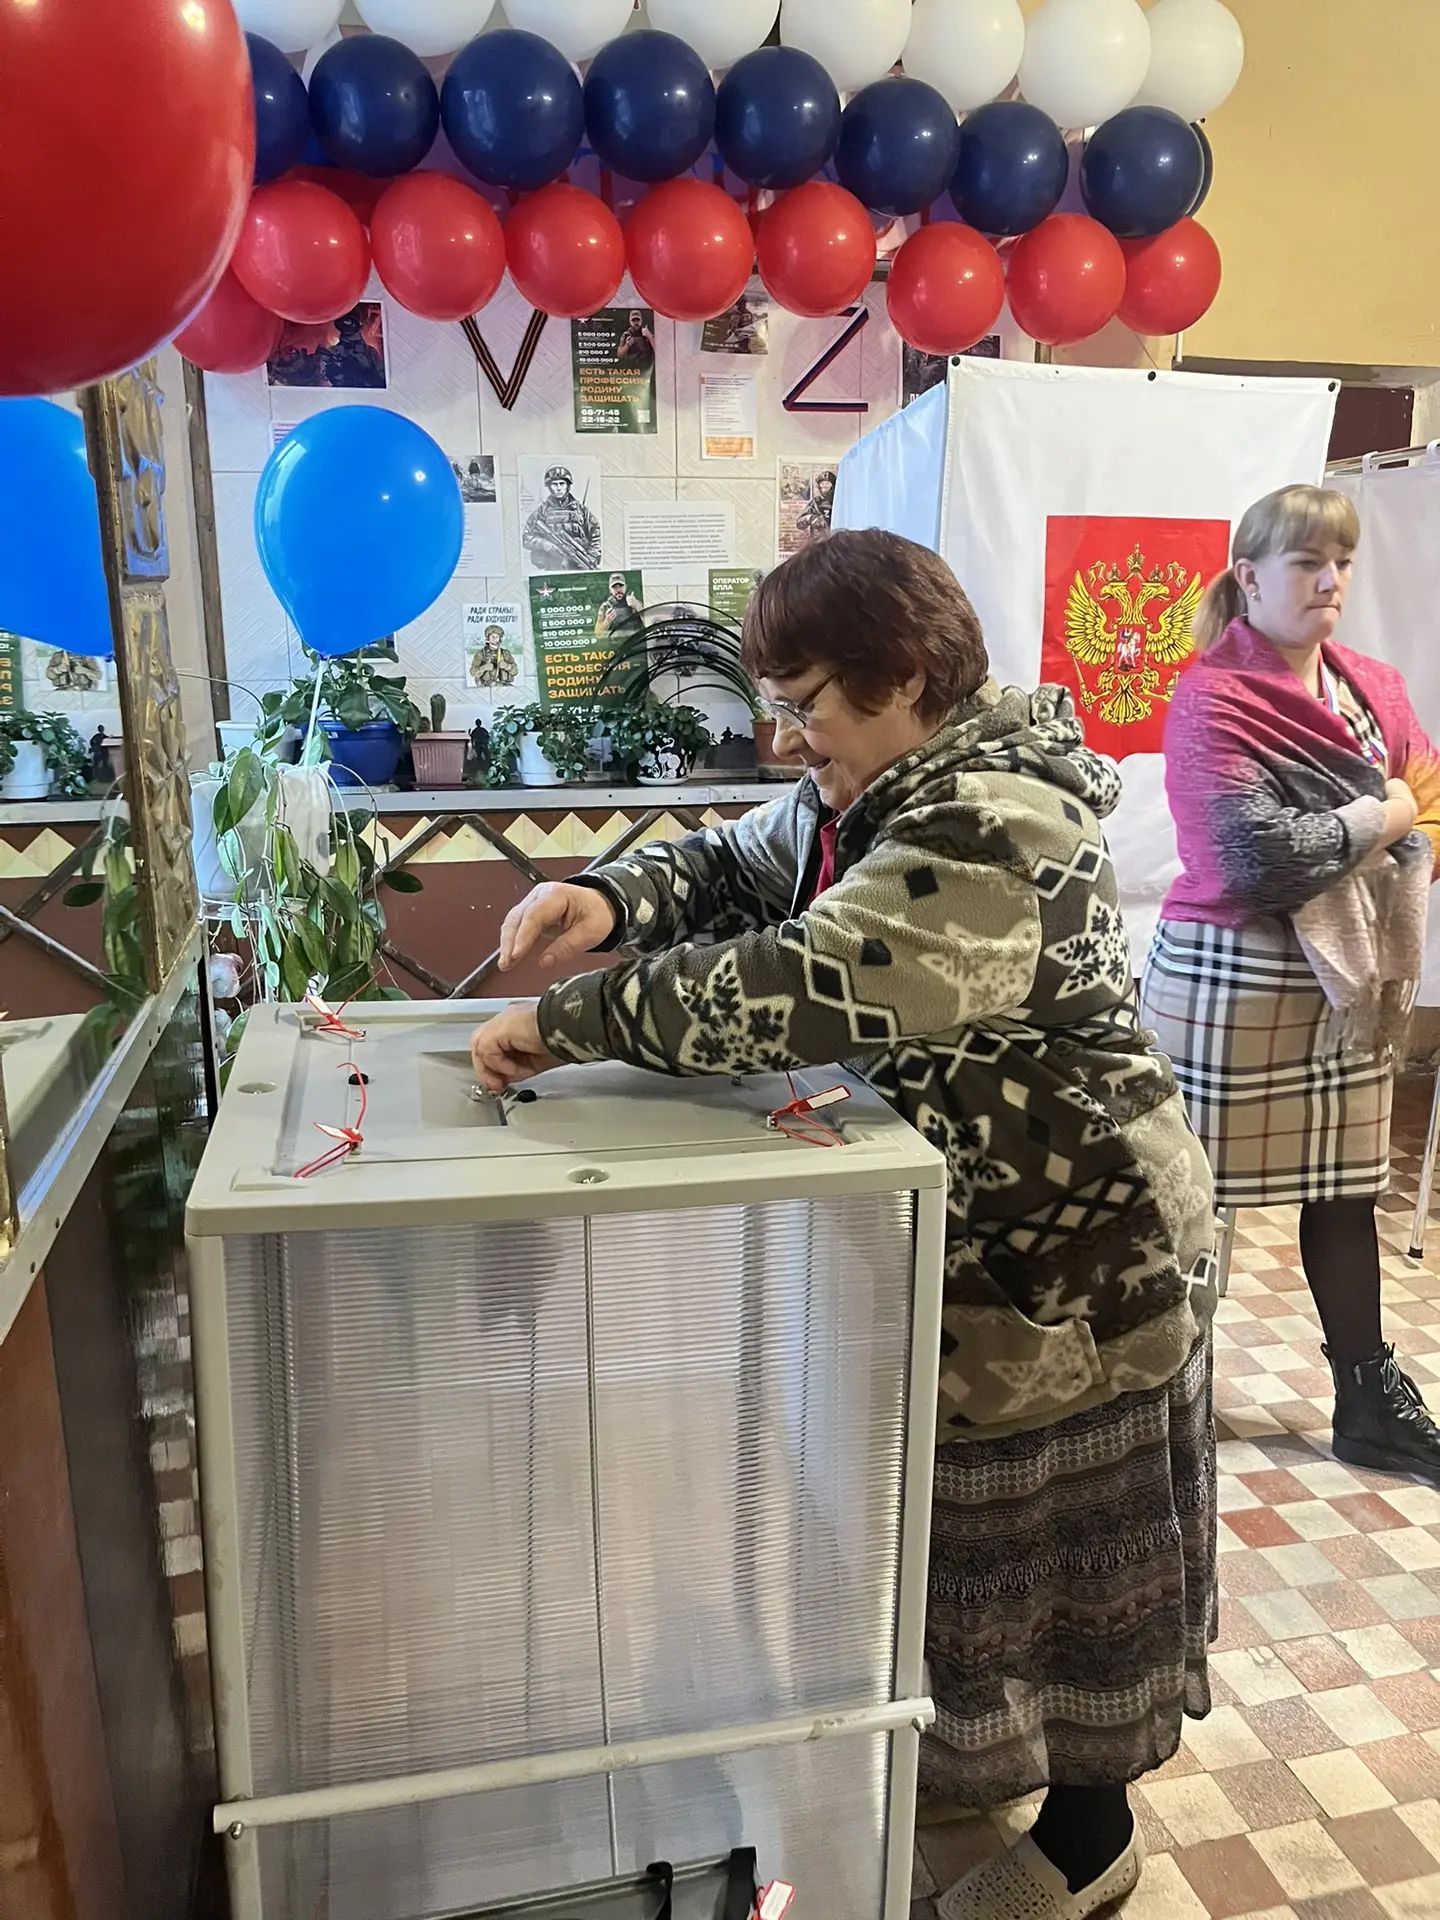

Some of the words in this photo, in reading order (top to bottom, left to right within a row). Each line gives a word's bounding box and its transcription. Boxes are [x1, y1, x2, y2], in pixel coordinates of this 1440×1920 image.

[608, 368, 641, 376] ТАКАЯ
[580, 377, 642, 385] ПРОФЕССИЯ
[580, 395, 641, 403] ЗАЩИЩАТЬ
[470, 606, 487, 615] РАДИ
[467, 615, 484, 623] РАДИ
[544, 653, 580, 663] ЕСТЬ
[582, 651, 619, 662] ТАКА
[546, 661, 631, 676] ПРОФЕСИЯ
